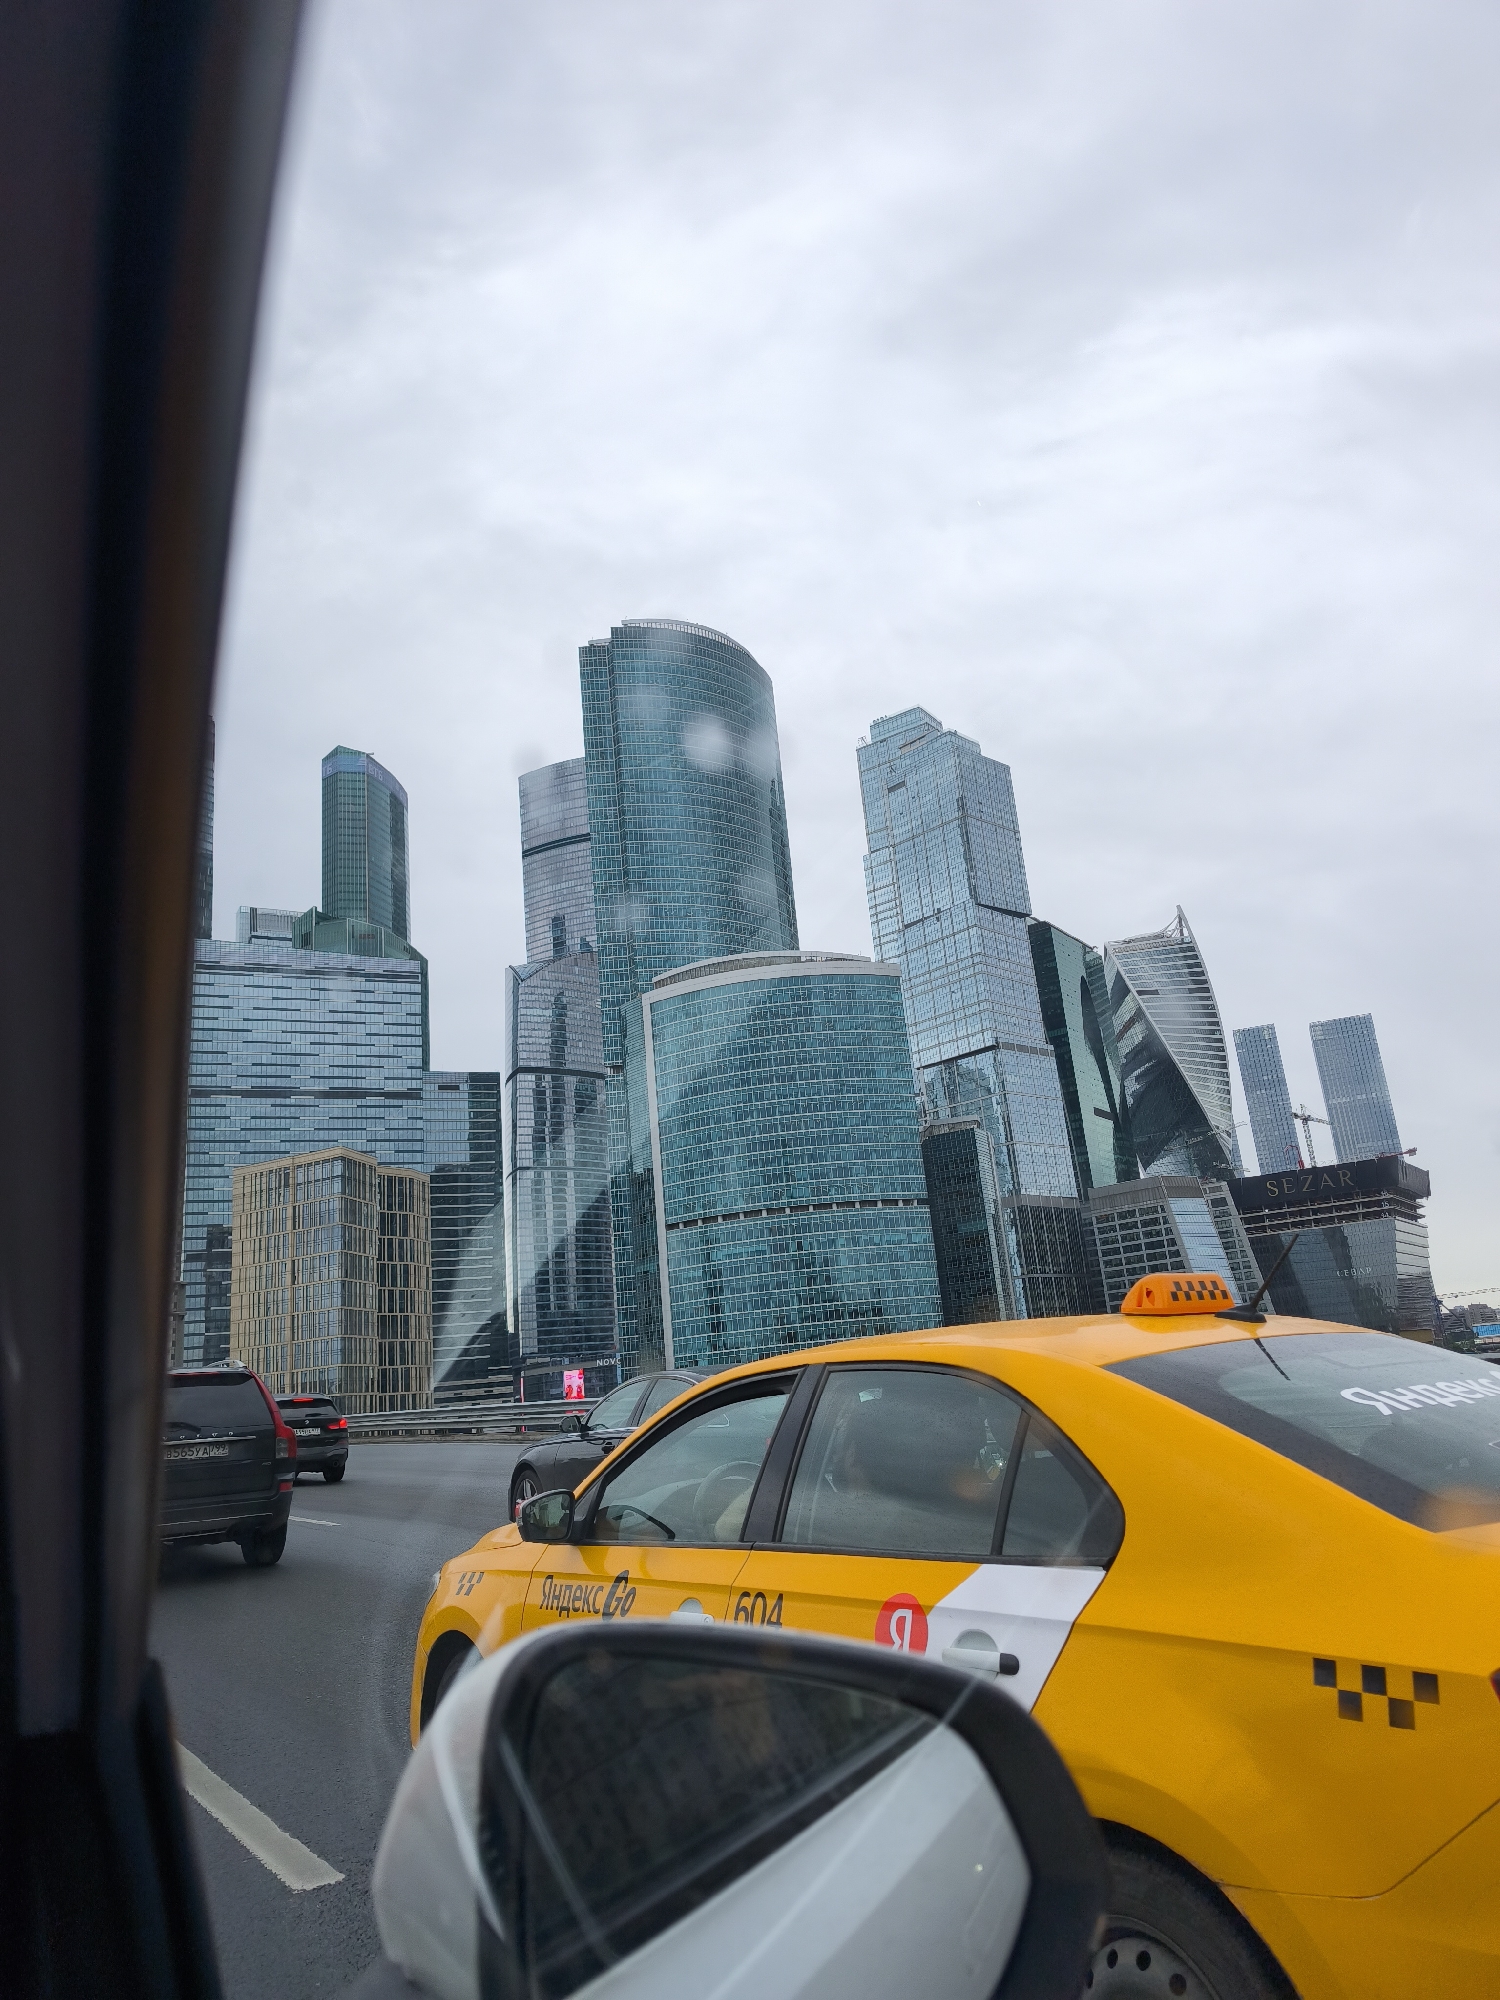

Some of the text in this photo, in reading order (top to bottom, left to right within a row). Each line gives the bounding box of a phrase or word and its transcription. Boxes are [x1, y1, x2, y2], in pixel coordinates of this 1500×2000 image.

[1266, 1169, 1354, 1197] SEZAR
[539, 1569, 637, 1622] Яндекс Go
[734, 1591, 784, 1629] 604
[889, 1608, 913, 1651] Я
